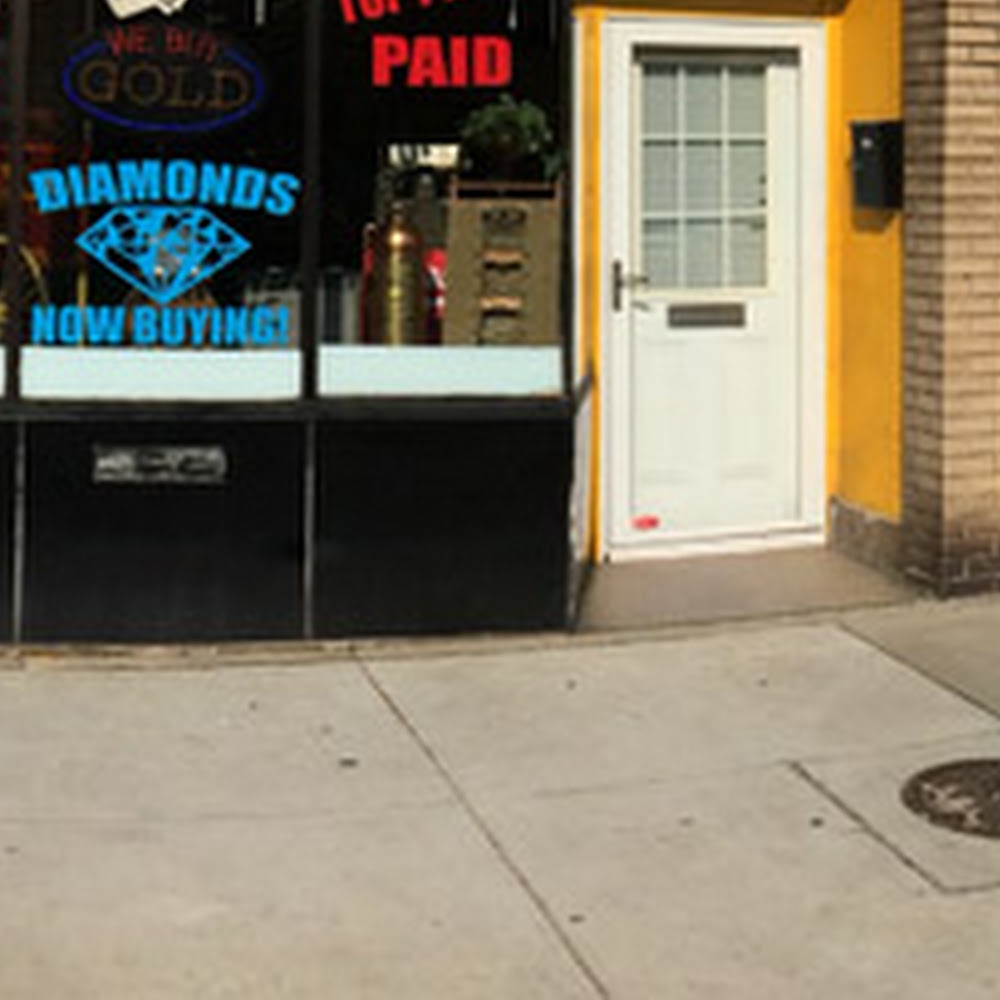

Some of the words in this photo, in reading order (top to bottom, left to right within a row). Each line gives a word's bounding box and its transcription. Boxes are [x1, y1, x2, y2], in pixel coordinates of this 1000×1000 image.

[105, 26, 153, 59] WE
[371, 34, 513, 87] PAID
[78, 58, 250, 112] GOLD
[30, 159, 300, 215] DIAMONDS
[31, 305, 126, 346] NOW
[131, 305, 290, 347] BUYING!
